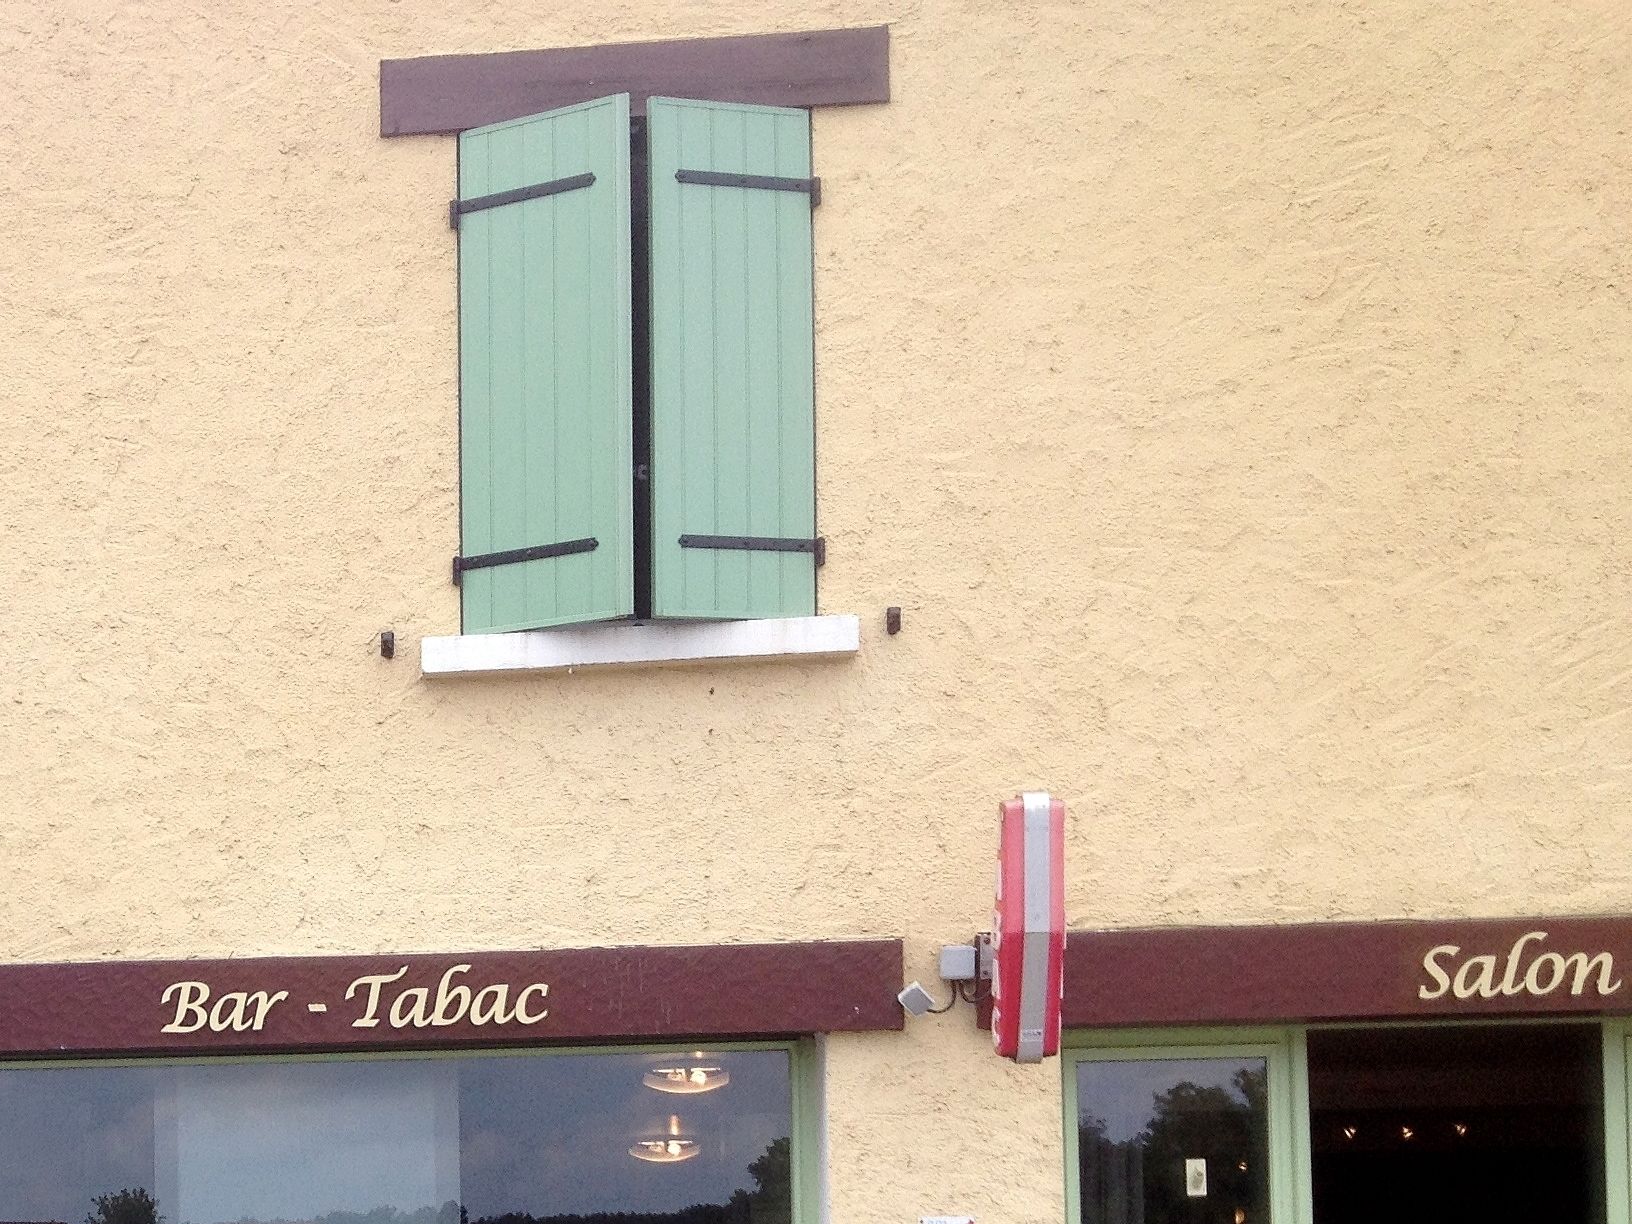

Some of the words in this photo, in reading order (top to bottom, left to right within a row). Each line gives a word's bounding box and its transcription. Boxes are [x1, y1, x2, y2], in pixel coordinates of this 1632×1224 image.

[160, 981, 288, 1033] Bar
[344, 964, 549, 1028] Tabac
[1418, 931, 1622, 1000] Salon
